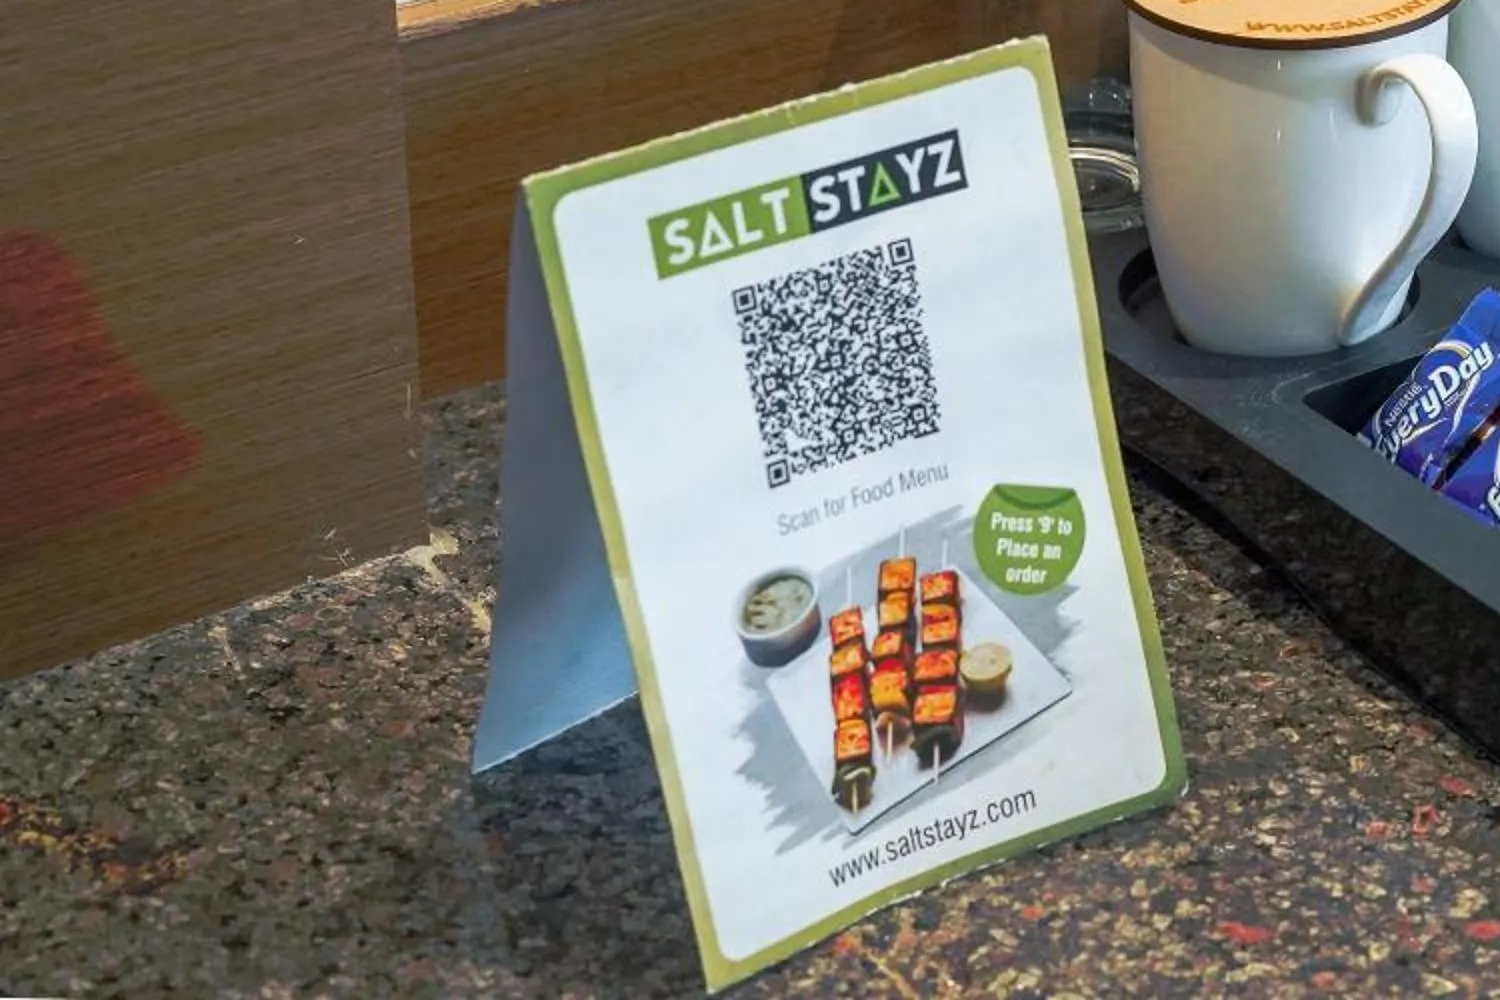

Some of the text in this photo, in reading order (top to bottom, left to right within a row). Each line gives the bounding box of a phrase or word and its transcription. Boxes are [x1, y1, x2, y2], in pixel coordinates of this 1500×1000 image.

[663, 137, 963, 266] SALT STAYZ
[776, 462, 951, 538] Scan for Food Menu
[990, 511, 1035, 534] Press
[1057, 517, 1073, 536] to
[996, 537, 1063, 561] Place an
[1004, 565, 1050, 586] order
[827, 788, 1038, 889] www.saltstayz.com
